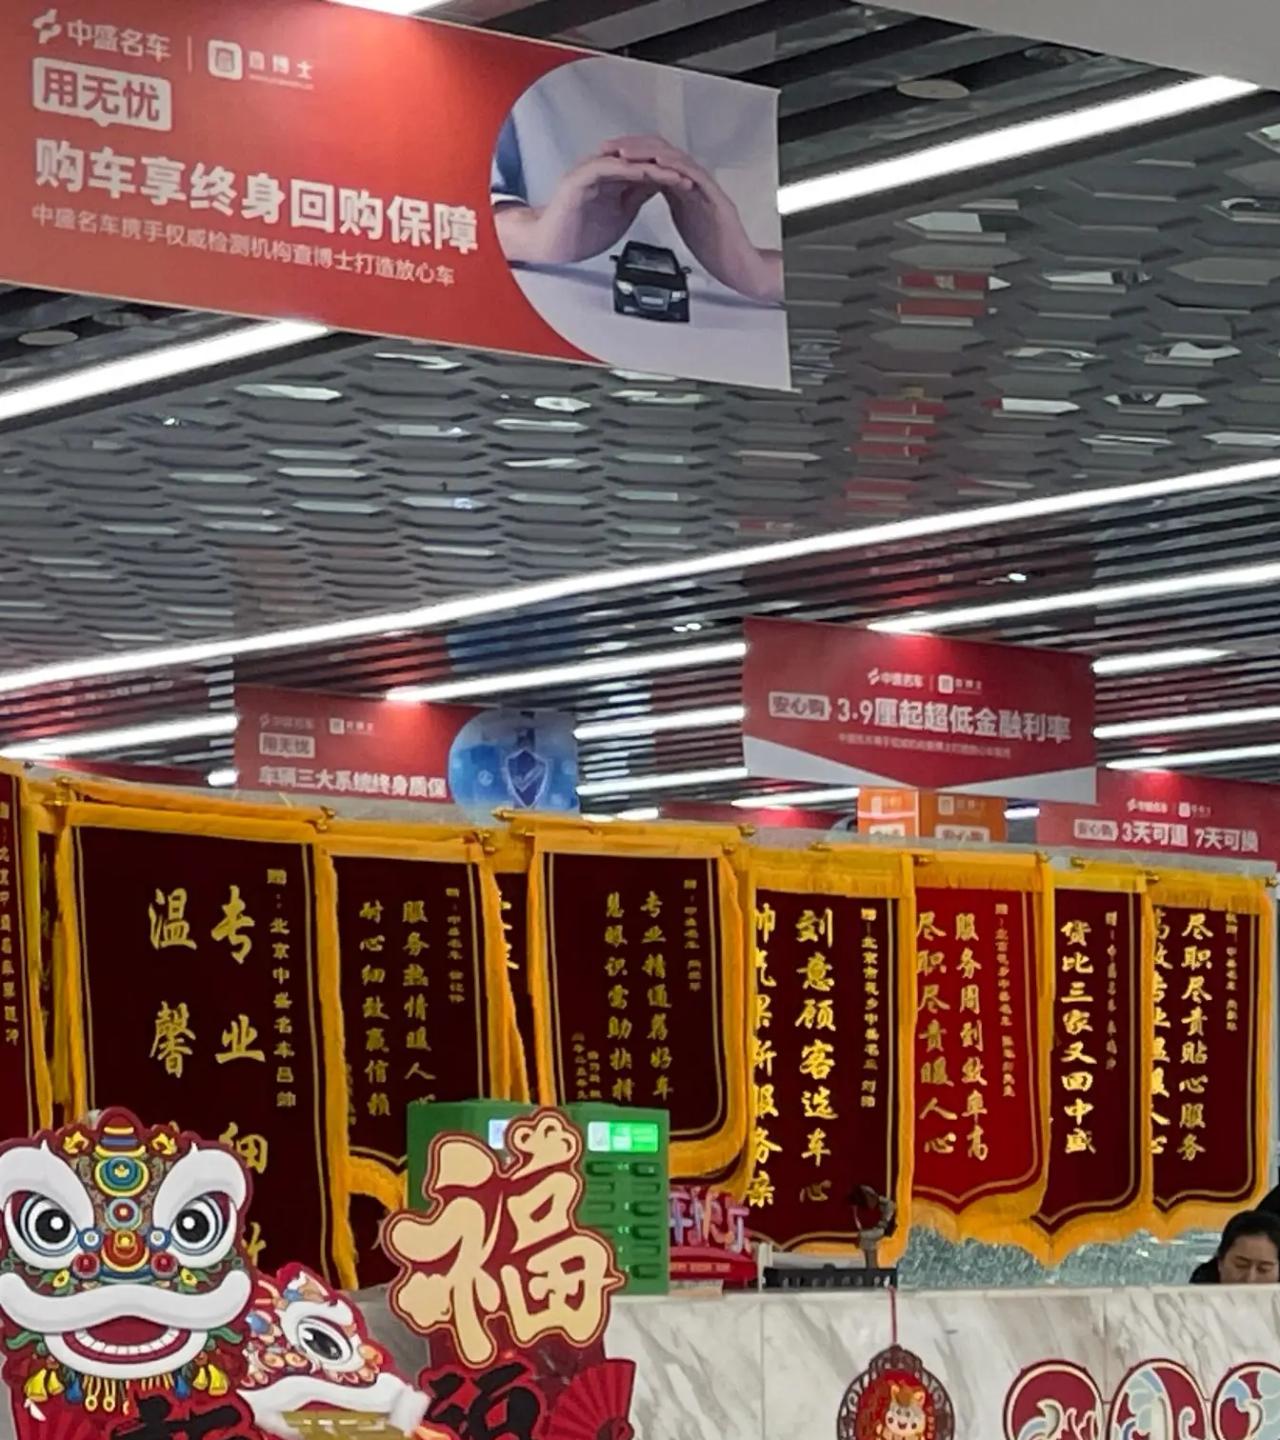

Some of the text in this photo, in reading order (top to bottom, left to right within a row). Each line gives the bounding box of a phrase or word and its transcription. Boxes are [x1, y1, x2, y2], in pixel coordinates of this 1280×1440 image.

[67, 18, 172, 62] 中盛名车
[43, 66, 160, 122] 用无忧
[35, 138, 479, 254] 购车享终身回购保障
[837, 698, 1072, 744] 3.9厘起超低金融利率
[259, 766, 448, 799] 车辆三大系统终身质保
[391, 1113, 618, 1362] 福
